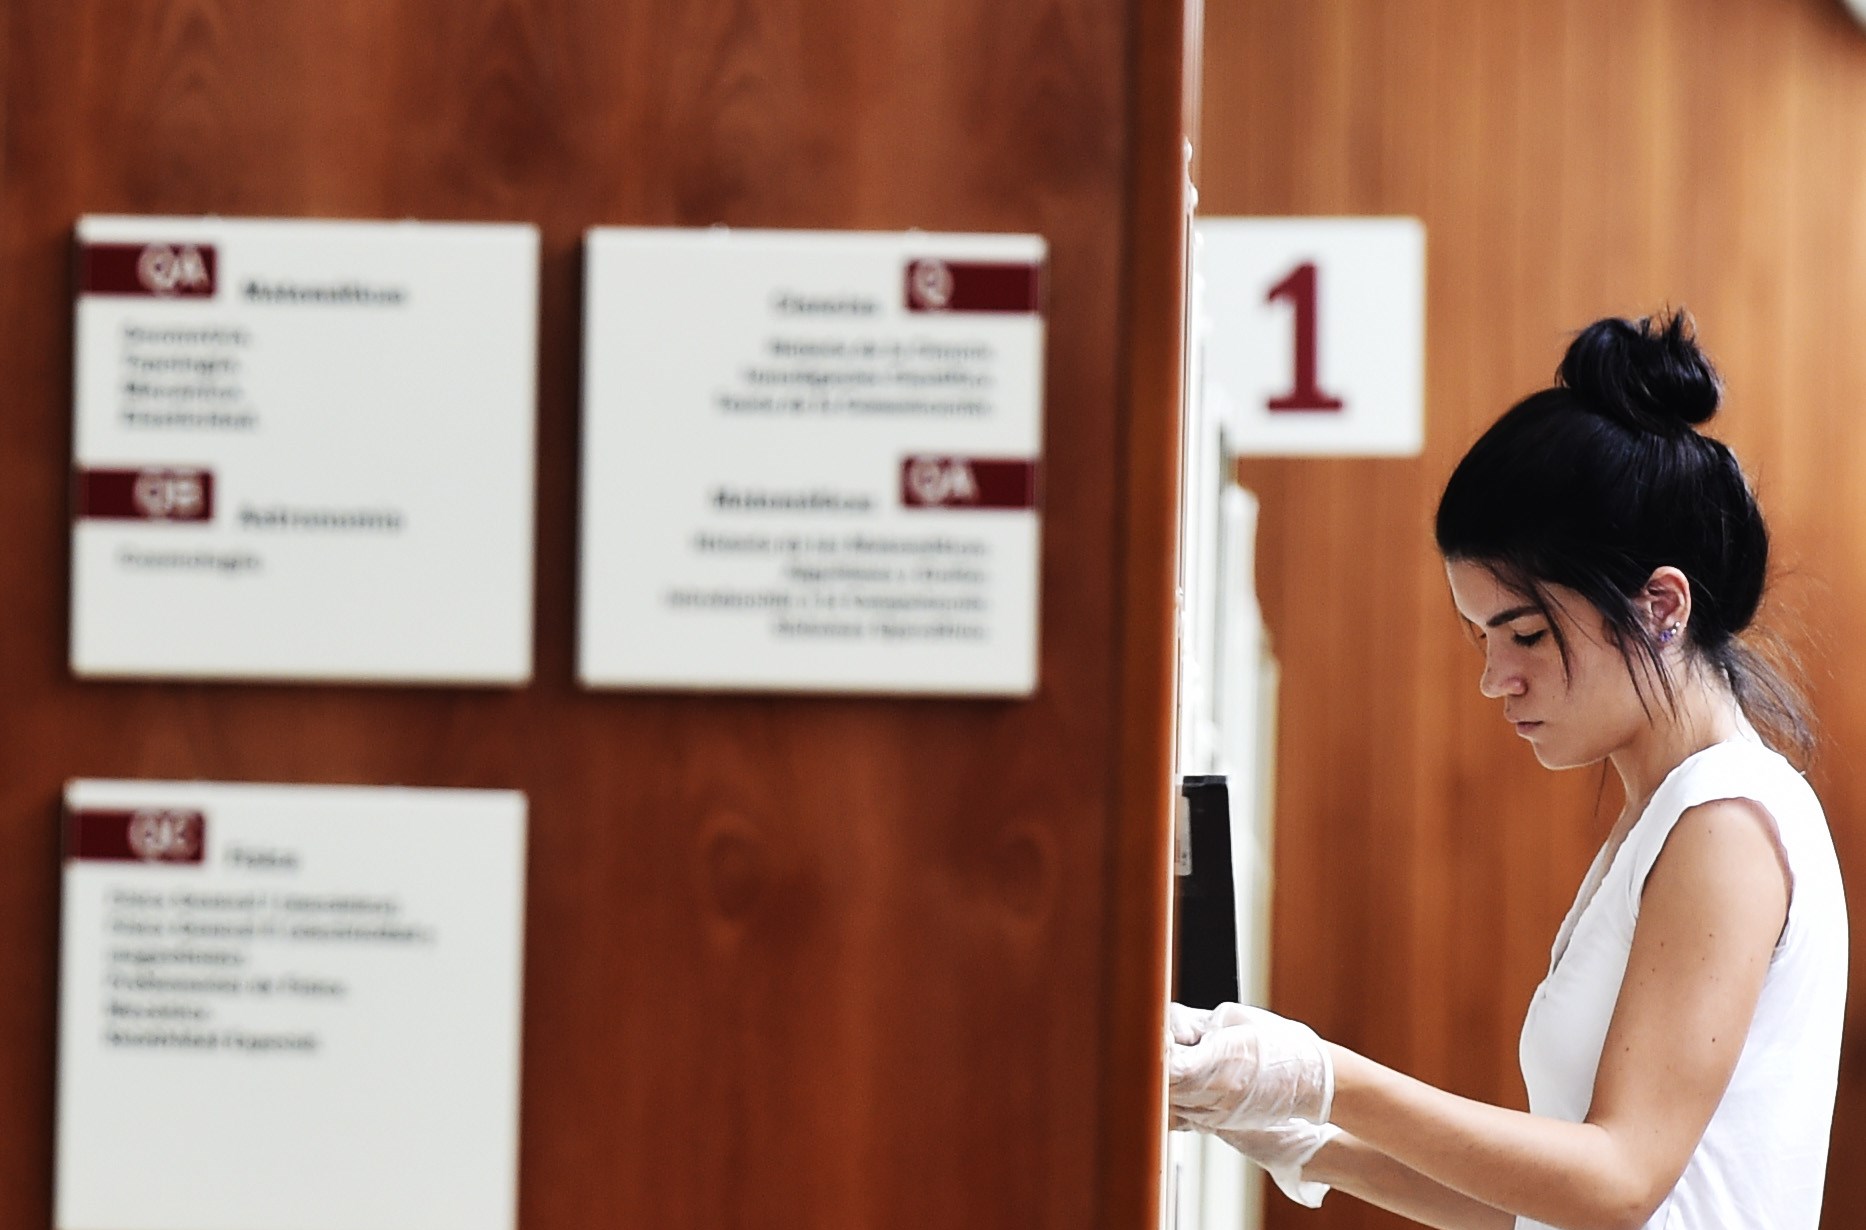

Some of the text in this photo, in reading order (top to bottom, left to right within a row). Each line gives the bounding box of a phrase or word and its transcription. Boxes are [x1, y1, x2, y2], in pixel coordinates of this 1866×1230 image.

[138, 246, 213, 294] QA
[910, 256, 954, 307] Q
[1265, 262, 1346, 413] 1
[134, 470, 206, 519] QB
[907, 454, 978, 507] QA
